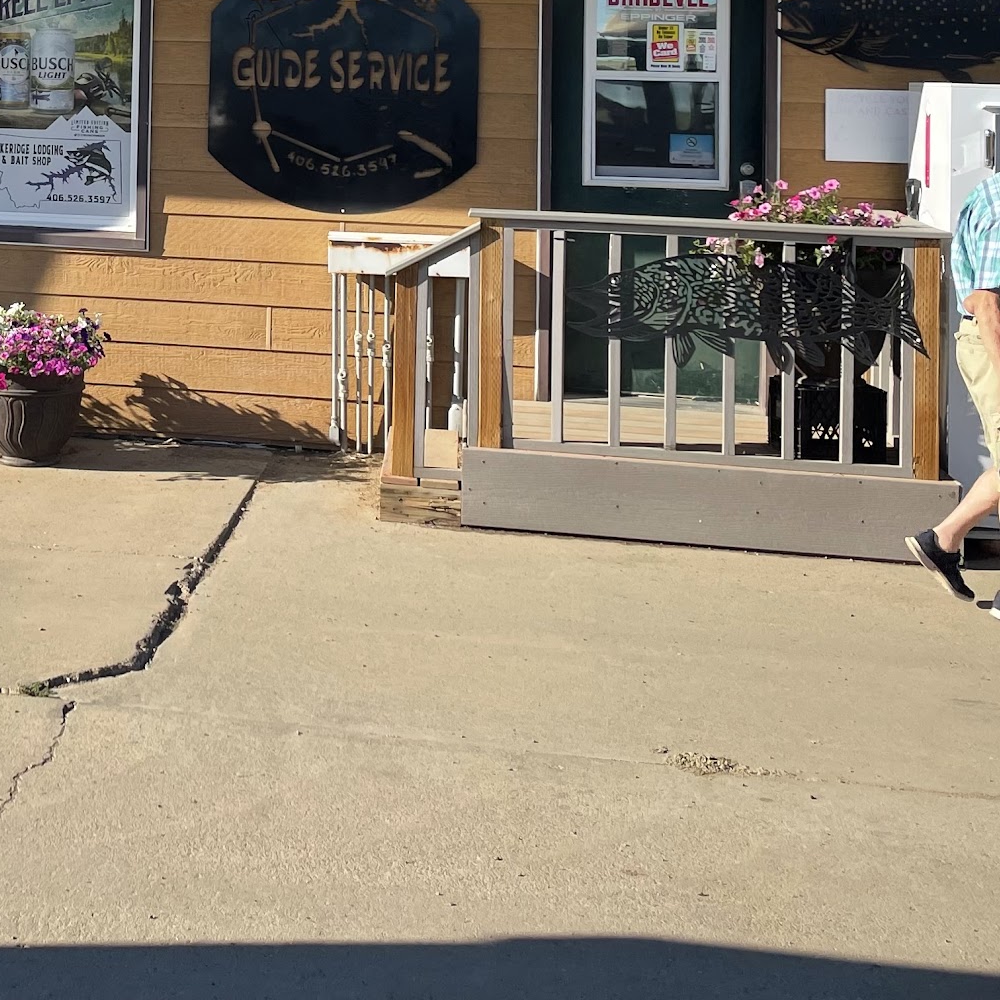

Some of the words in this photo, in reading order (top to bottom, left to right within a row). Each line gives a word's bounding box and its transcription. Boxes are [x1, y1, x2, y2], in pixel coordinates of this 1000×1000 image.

[620, 14, 697, 22] EPPINGER
[656, 42, 674, 50] We
[653, 48, 678, 57] Card
[32, 57, 74, 72] BUSCH
[232, 47, 321, 90] GUIDE
[329, 49, 451, 92] SERVICE
[38, 71, 67, 79] LIGHT
[33, 144, 64, 156] LODGING
[1, 155, 7, 165] &
[10, 155, 29, 165] BAIT
[32, 156, 52, 166] SHOP
[46, 194, 111, 204] 406.526.3597
